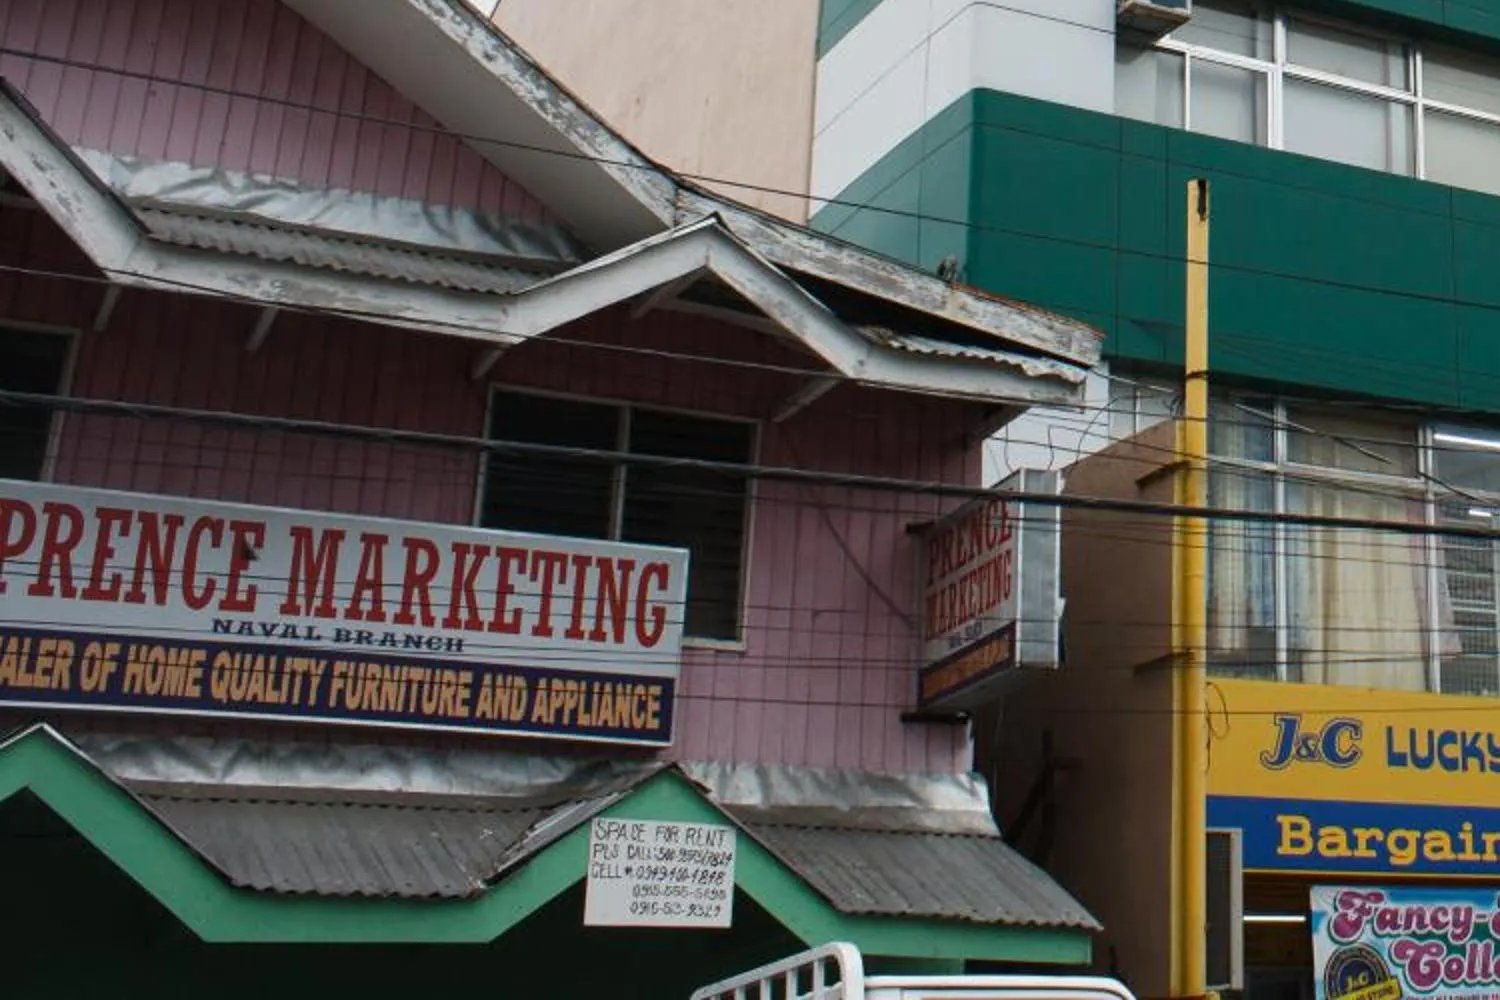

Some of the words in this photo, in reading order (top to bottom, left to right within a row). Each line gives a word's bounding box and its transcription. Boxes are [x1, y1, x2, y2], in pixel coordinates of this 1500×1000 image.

[926, 492, 1012, 590] PRENCE
[280, 526, 669, 648] MARKETING
[925, 551, 1011, 642] MARKETING
[212, 618, 322, 642] NAVAL
[331, 627, 464, 653] BRANCH
[0, 636, 75, 691] ALER
[80, 641, 121, 693] OF
[122, 645, 207, 698] HOME
[211, 651, 329, 710] QUALITY
[330, 660, 474, 718] FURNITURE
[476, 673, 528, 724] AND
[531, 677, 662, 731] APPLIANCE
[1259, 713, 1363, 770] J&C
[594, 819, 647, 842] SPACE
